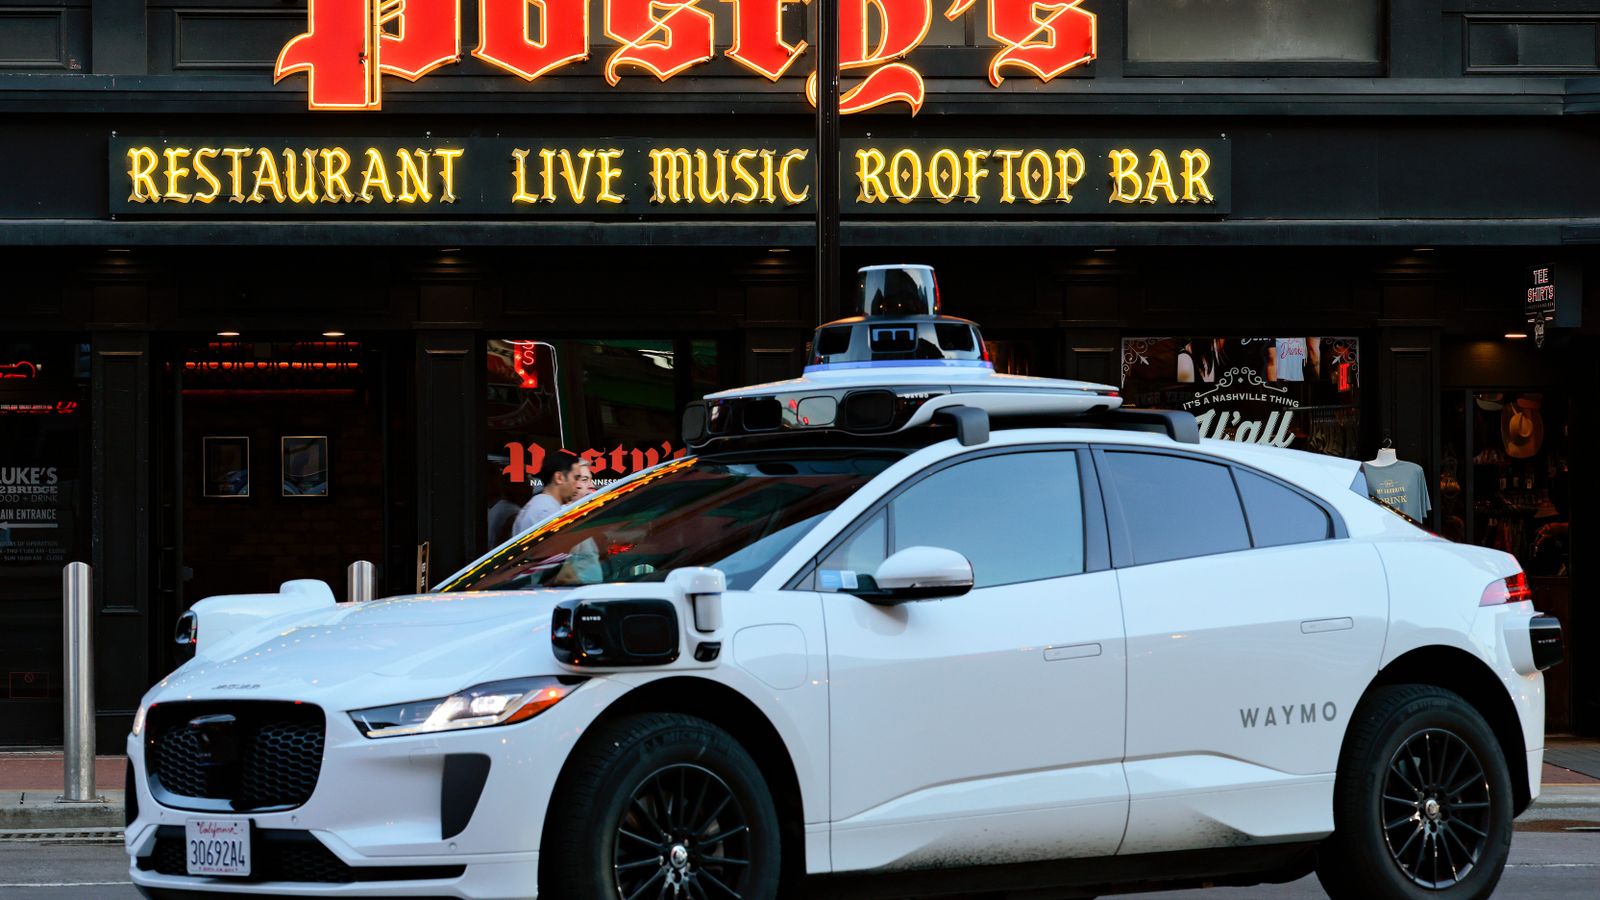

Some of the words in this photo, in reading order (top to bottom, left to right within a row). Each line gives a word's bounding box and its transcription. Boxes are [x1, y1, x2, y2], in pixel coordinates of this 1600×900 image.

[273, 0, 1098, 118] Postys
[127, 146, 464, 204] RESTAURANT
[512, 148, 626, 205] LIVE
[649, 148, 809, 205] MUSIC
[855, 148, 1086, 204] ROOFTOP
[1108, 148, 1215, 205] BAR
[1533, 268, 1549, 285] TEE
[1527, 285, 1554, 302] SHIRTS
[1183, 399, 1200, 410] IT'S
[1203, 397, 1210, 405] A
[1212, 393, 1267, 403] NASHVILLE
[1269, 395, 1299, 408] THING
[502, 441, 687, 482] Psty'
[0, 467, 58, 485] UKE'S
[0, 494, 20, 502] OOD
[31, 494, 58, 502] DRINK
[0, 508, 14, 520] AIN
[16, 508, 57, 520] ENTRANCE
[1239, 701, 1337, 728] WAYMO
[199, 822, 239, 838] California
[190, 840, 246, 867] 30692A4
